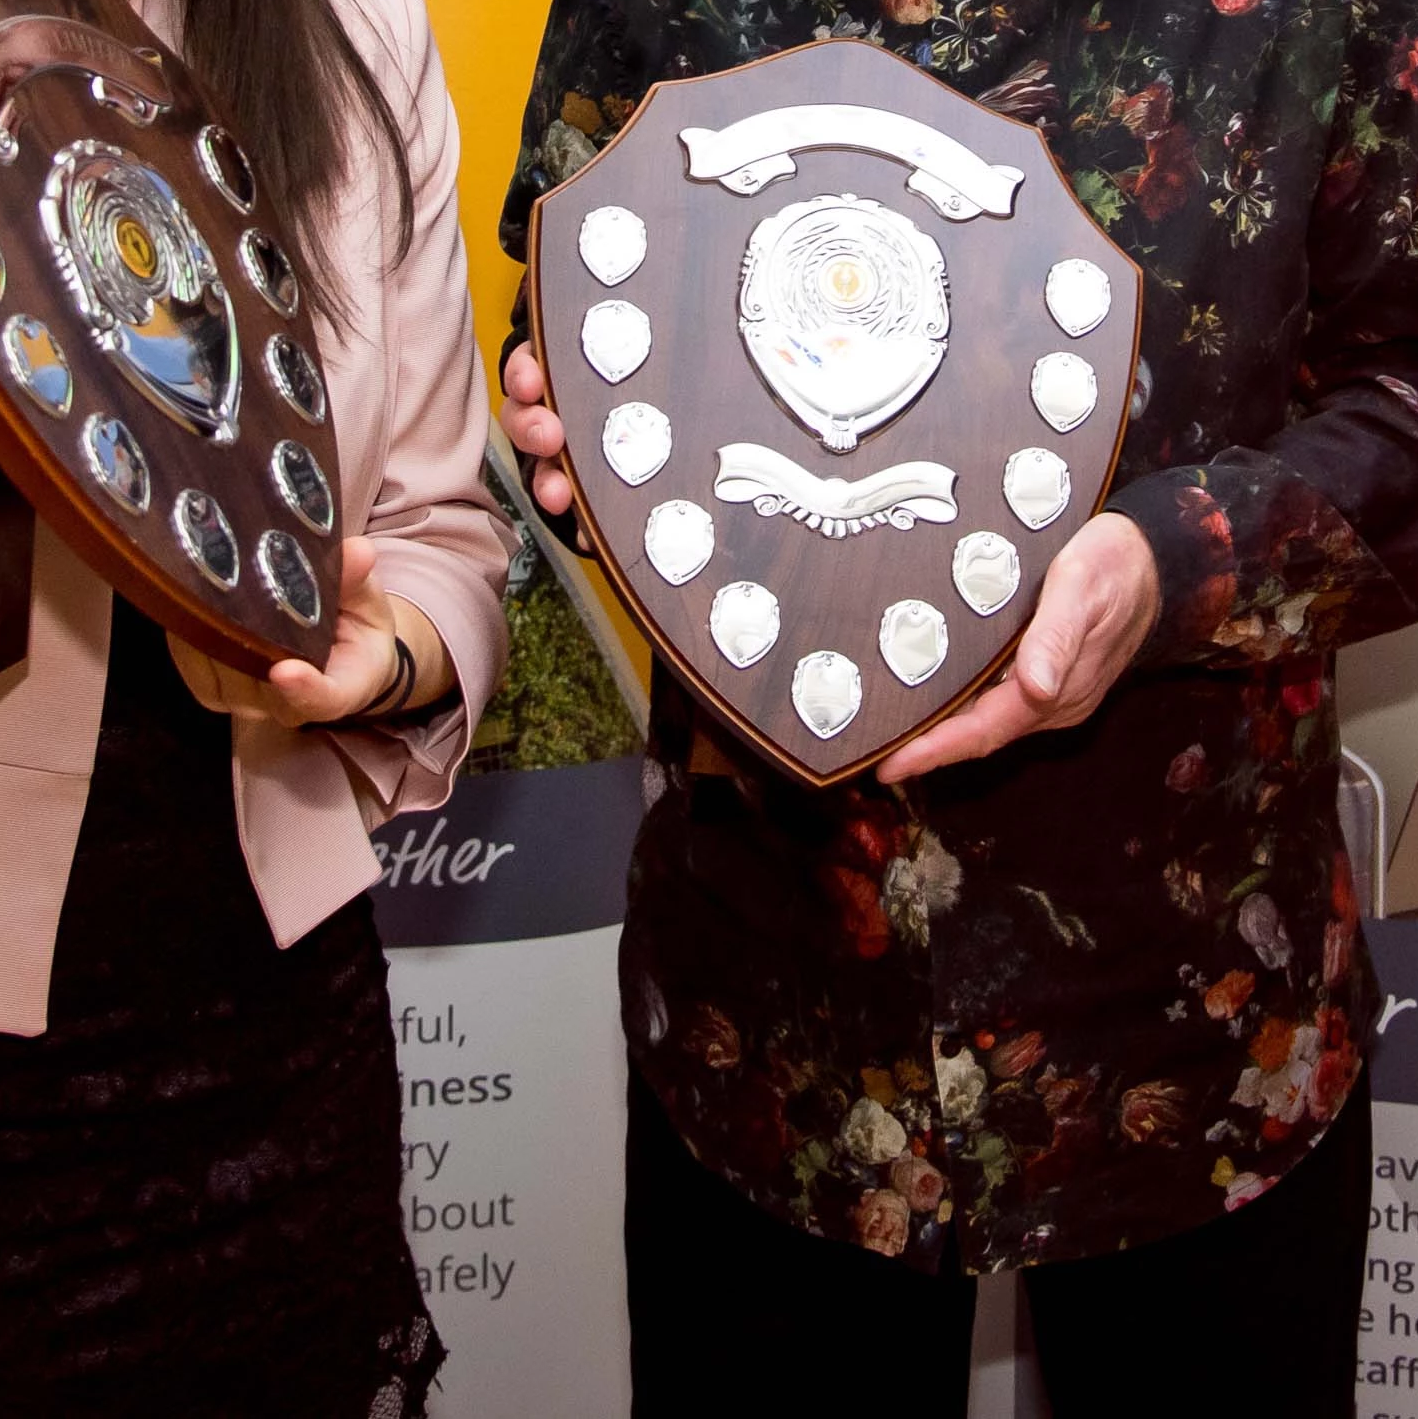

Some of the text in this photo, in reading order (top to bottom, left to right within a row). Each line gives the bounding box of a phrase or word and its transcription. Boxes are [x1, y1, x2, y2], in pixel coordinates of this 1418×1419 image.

[370, 816, 516, 888] ether
[398, 1003, 466, 1048] ful,
[401, 1139, 450, 1181] ry
[411, 1193, 516, 1232] bout
[417, 1251, 516, 1302] afely
[1367, 1256, 1416, 1295] ng
